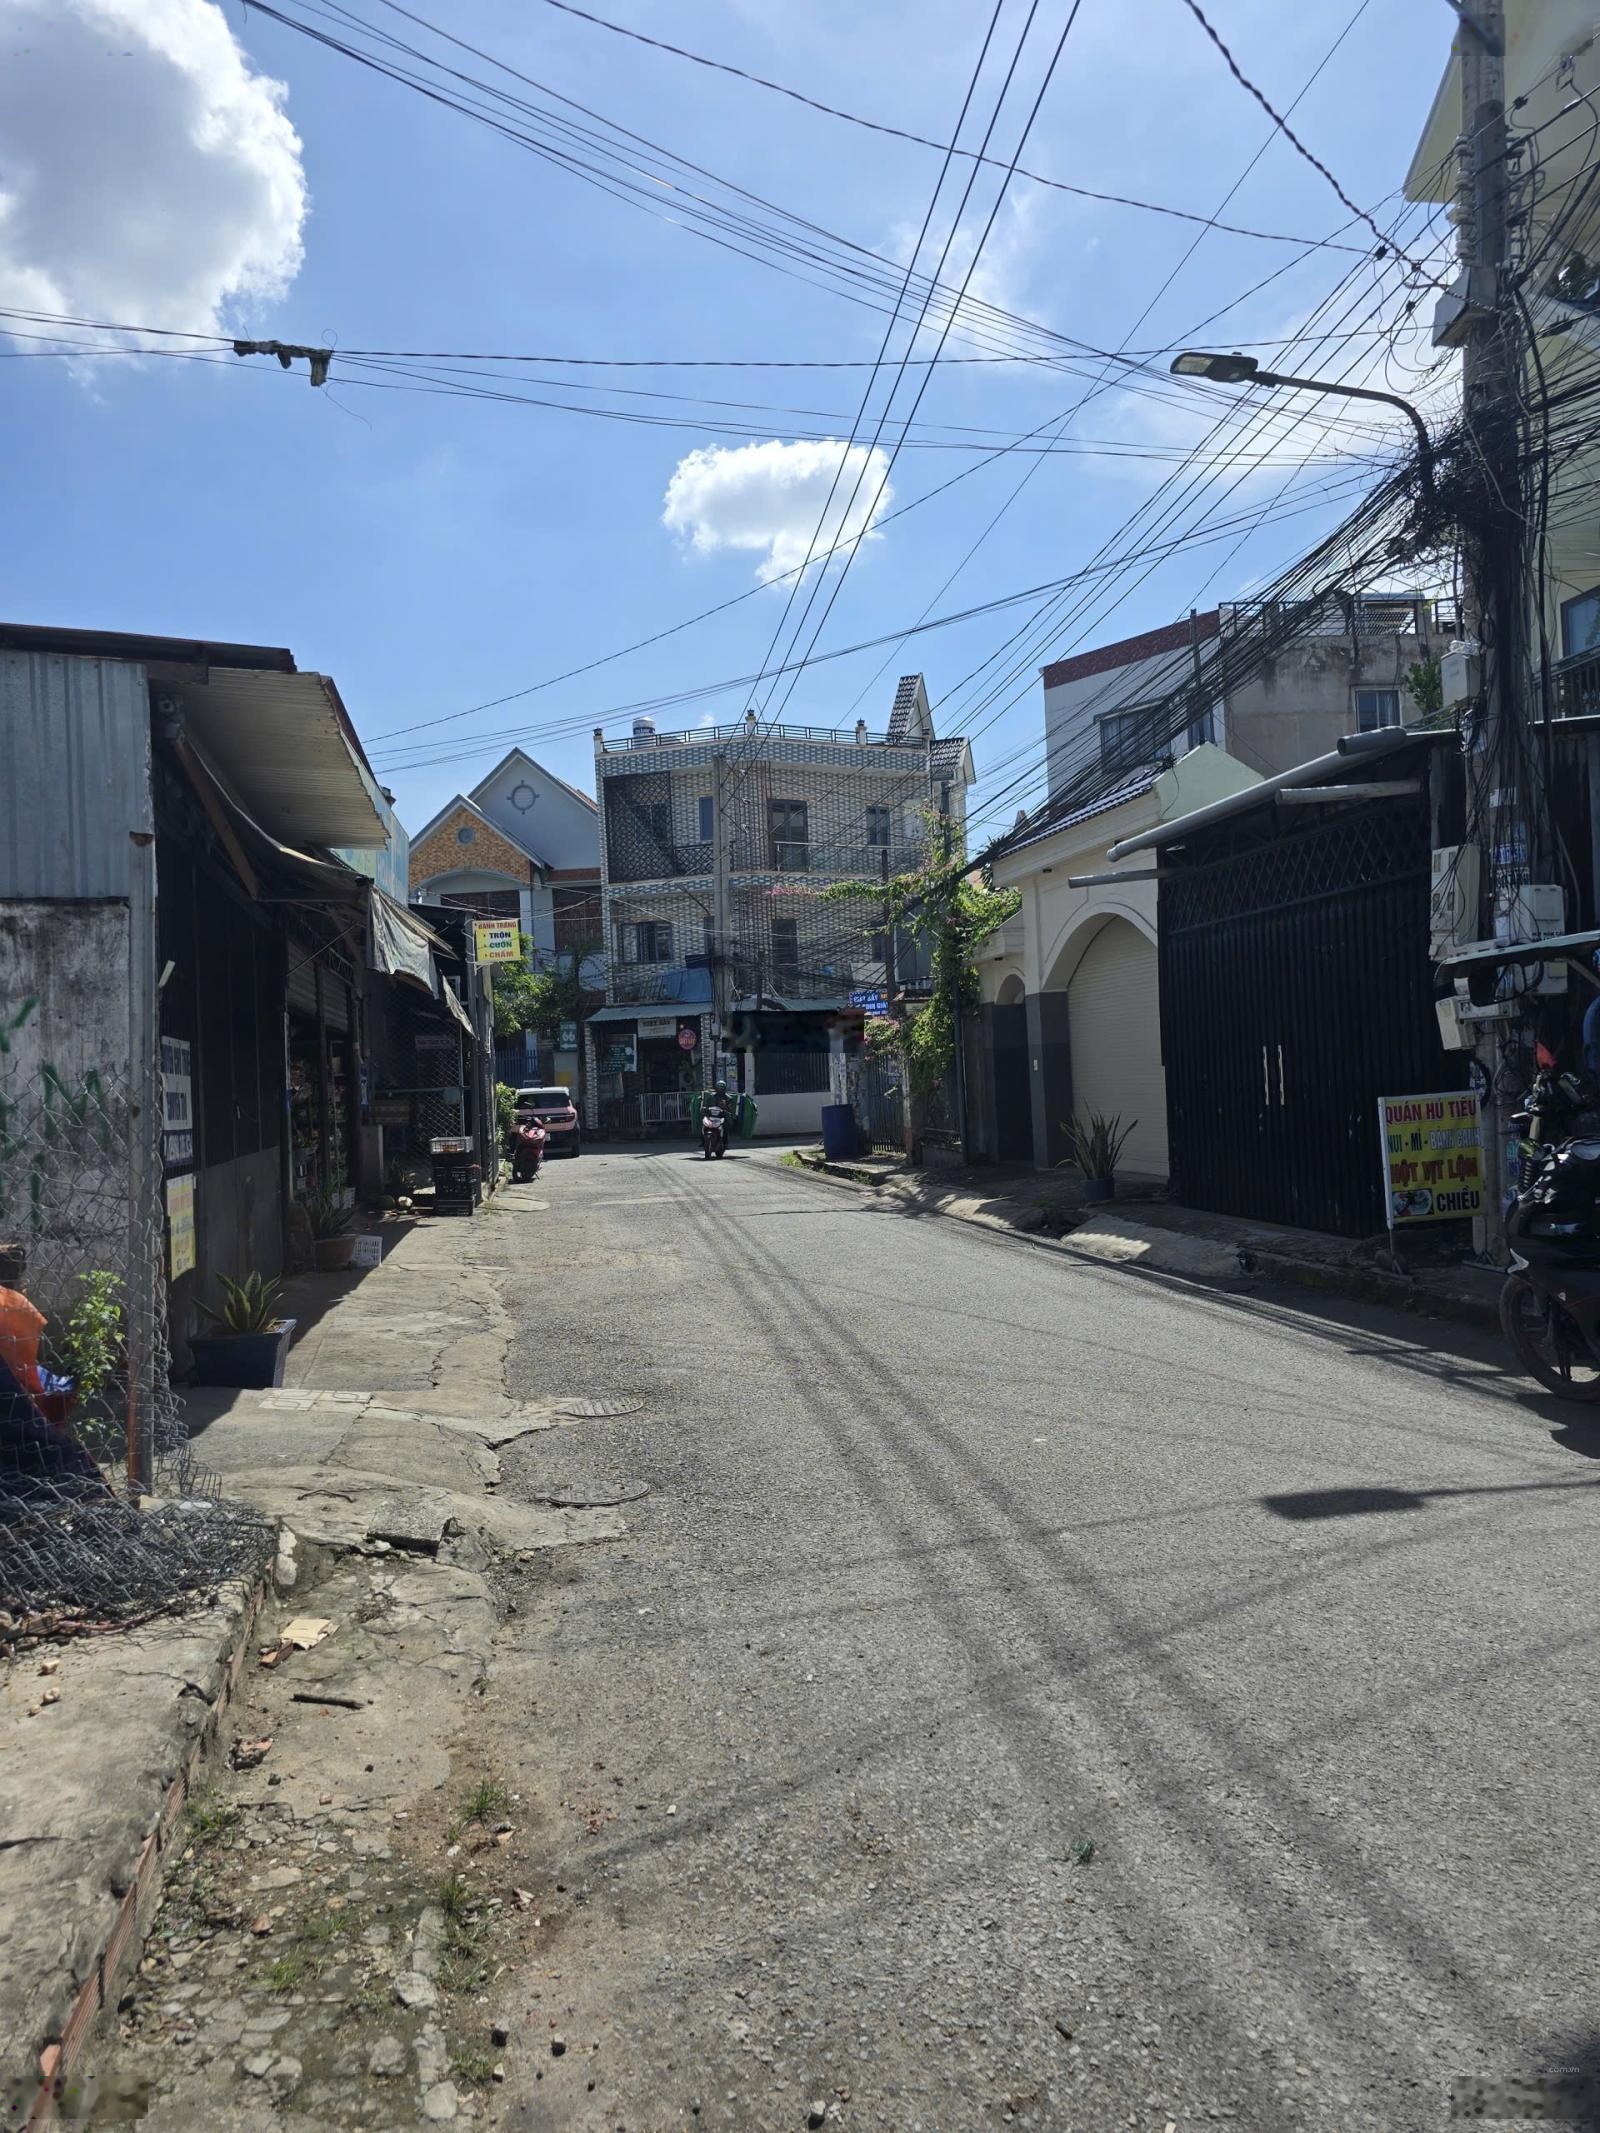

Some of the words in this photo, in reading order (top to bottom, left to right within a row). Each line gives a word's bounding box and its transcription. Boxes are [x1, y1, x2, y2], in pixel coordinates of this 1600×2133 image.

[562, 1031, 576, 1041] 66
[1385, 1101, 1422, 1125] QUÁN
[1436, 1185, 1480, 1212] CHIỀU
